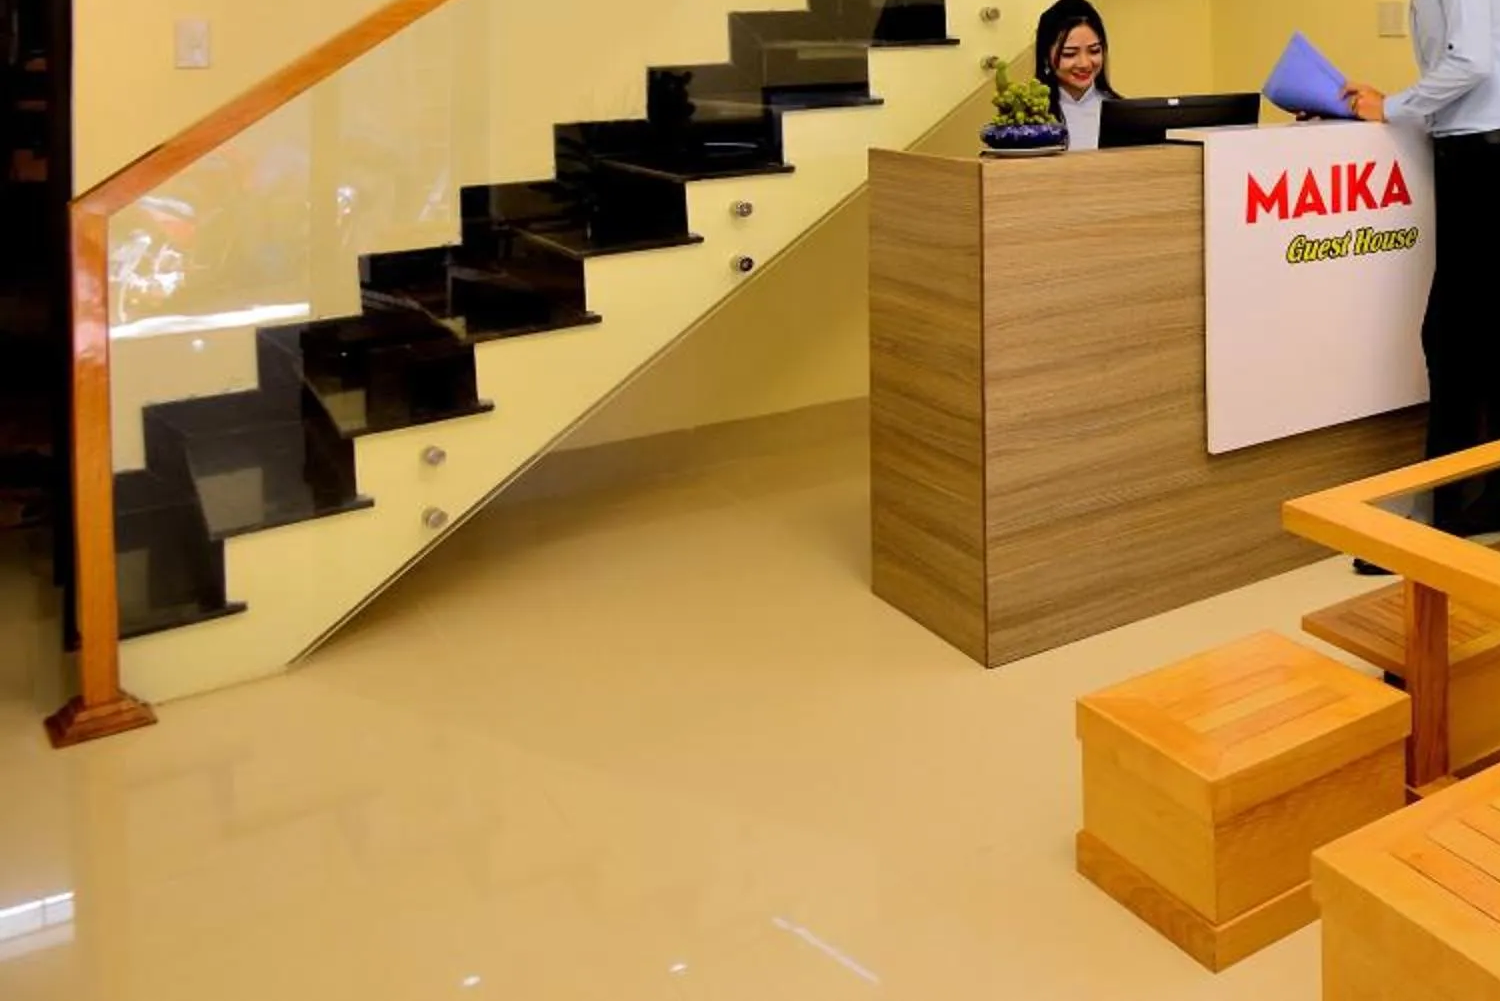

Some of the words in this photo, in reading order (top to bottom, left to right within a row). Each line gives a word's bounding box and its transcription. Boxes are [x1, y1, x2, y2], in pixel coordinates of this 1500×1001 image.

[1245, 160, 1412, 224] MAIKA
[1286, 230, 1352, 264] Guest
[1353, 226, 1418, 256] House
